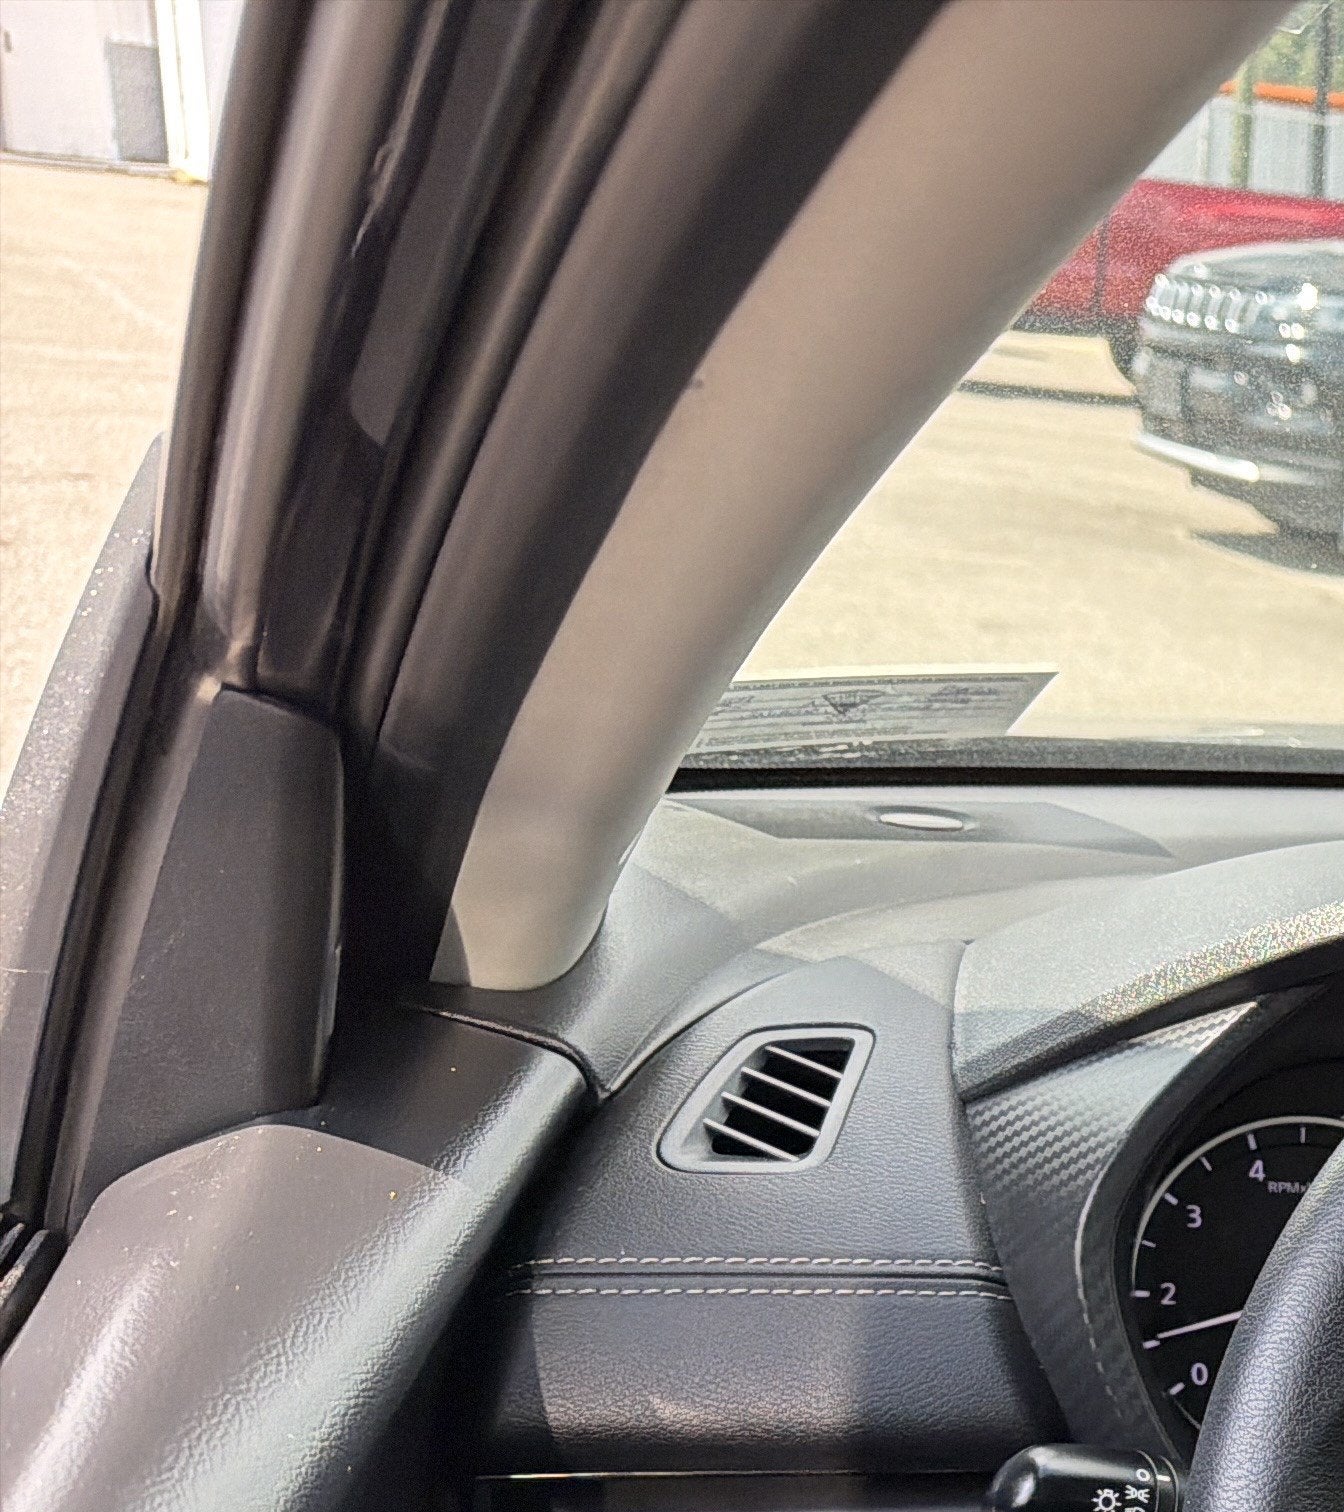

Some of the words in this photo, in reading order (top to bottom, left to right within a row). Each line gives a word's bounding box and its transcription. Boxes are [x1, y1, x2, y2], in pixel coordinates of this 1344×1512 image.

[1249, 1159, 1266, 1182] 4
[1185, 1204, 1202, 1228] 3
[1160, 1282, 1177, 1305] 2
[1190, 1363, 1208, 1386] 0
